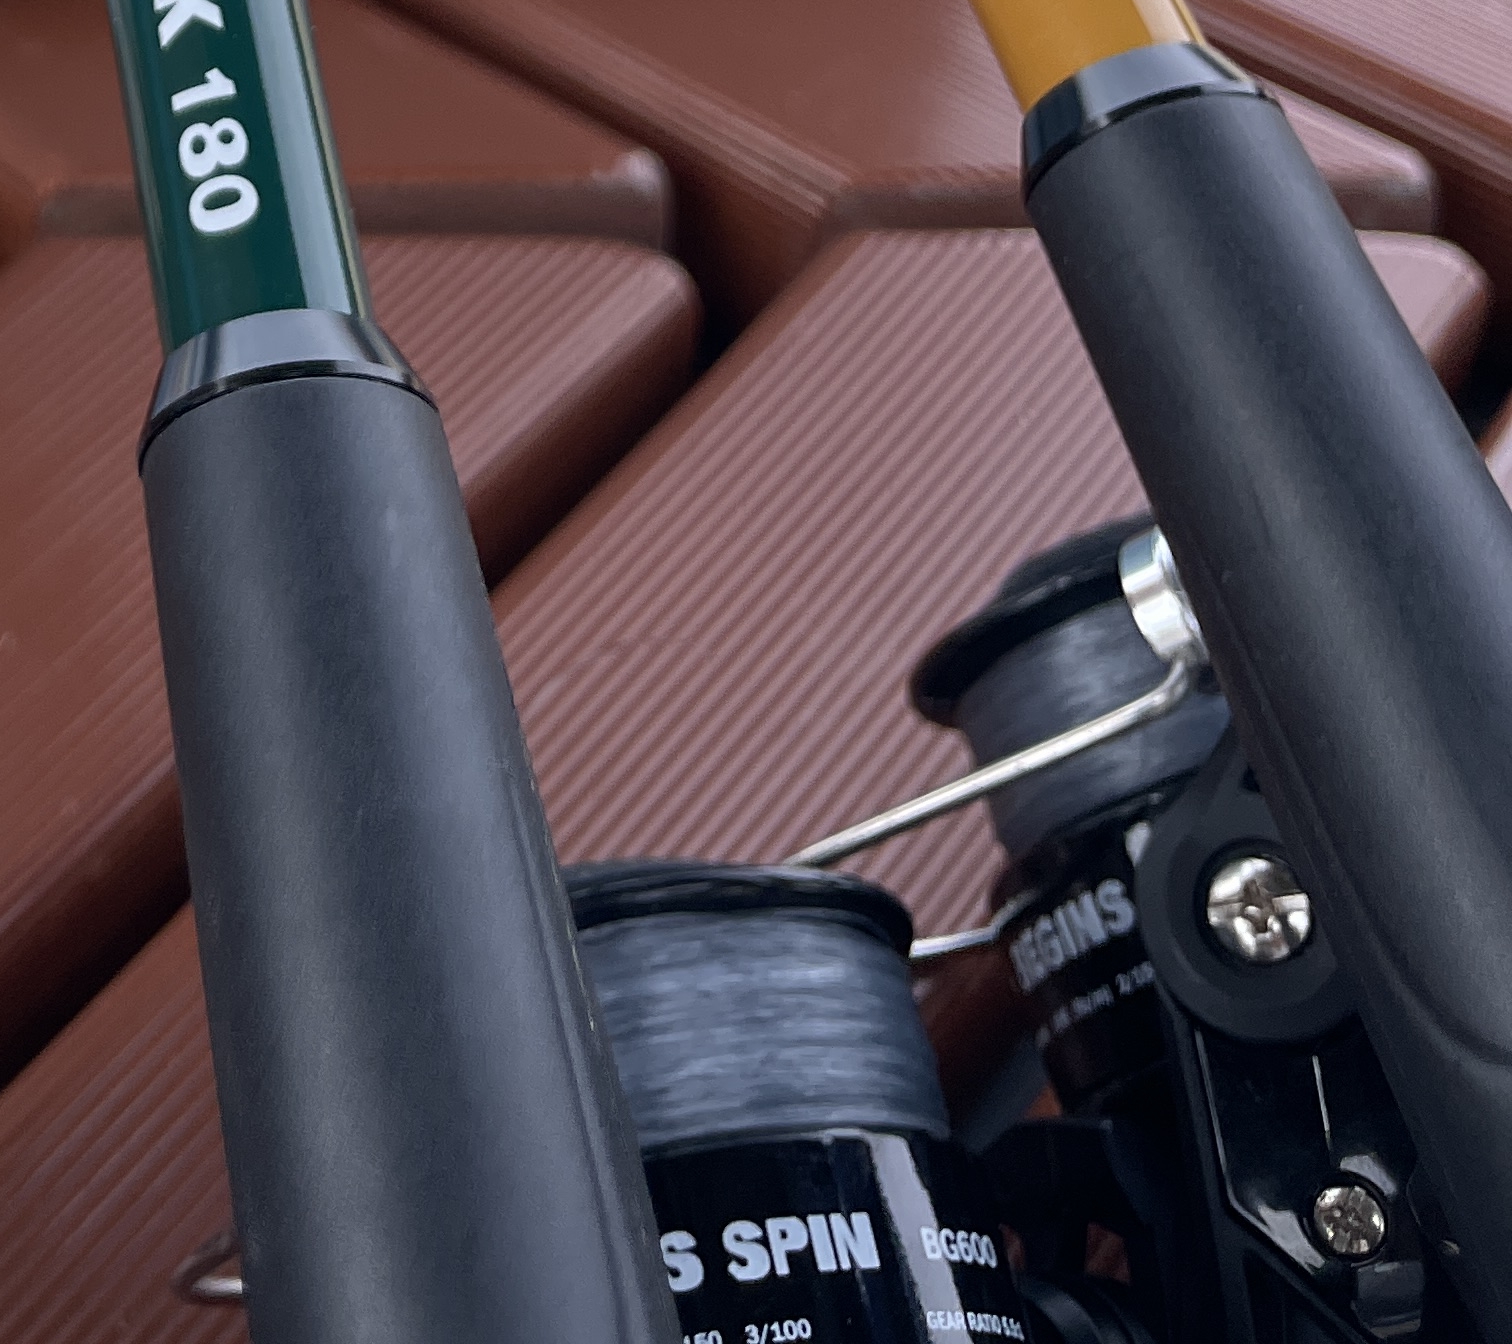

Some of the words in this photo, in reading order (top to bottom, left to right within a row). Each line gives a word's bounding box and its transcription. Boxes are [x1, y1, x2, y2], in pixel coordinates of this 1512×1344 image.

[171, 67, 260, 235] 180
[722, 1212, 881, 1283] SPIN
[920, 1225, 998, 1268] BG600
[744, 1318, 812, 1344] 3/100
[927, 1311, 966, 1330] GEAR
[967, 1311, 1001, 1335] RATIO
